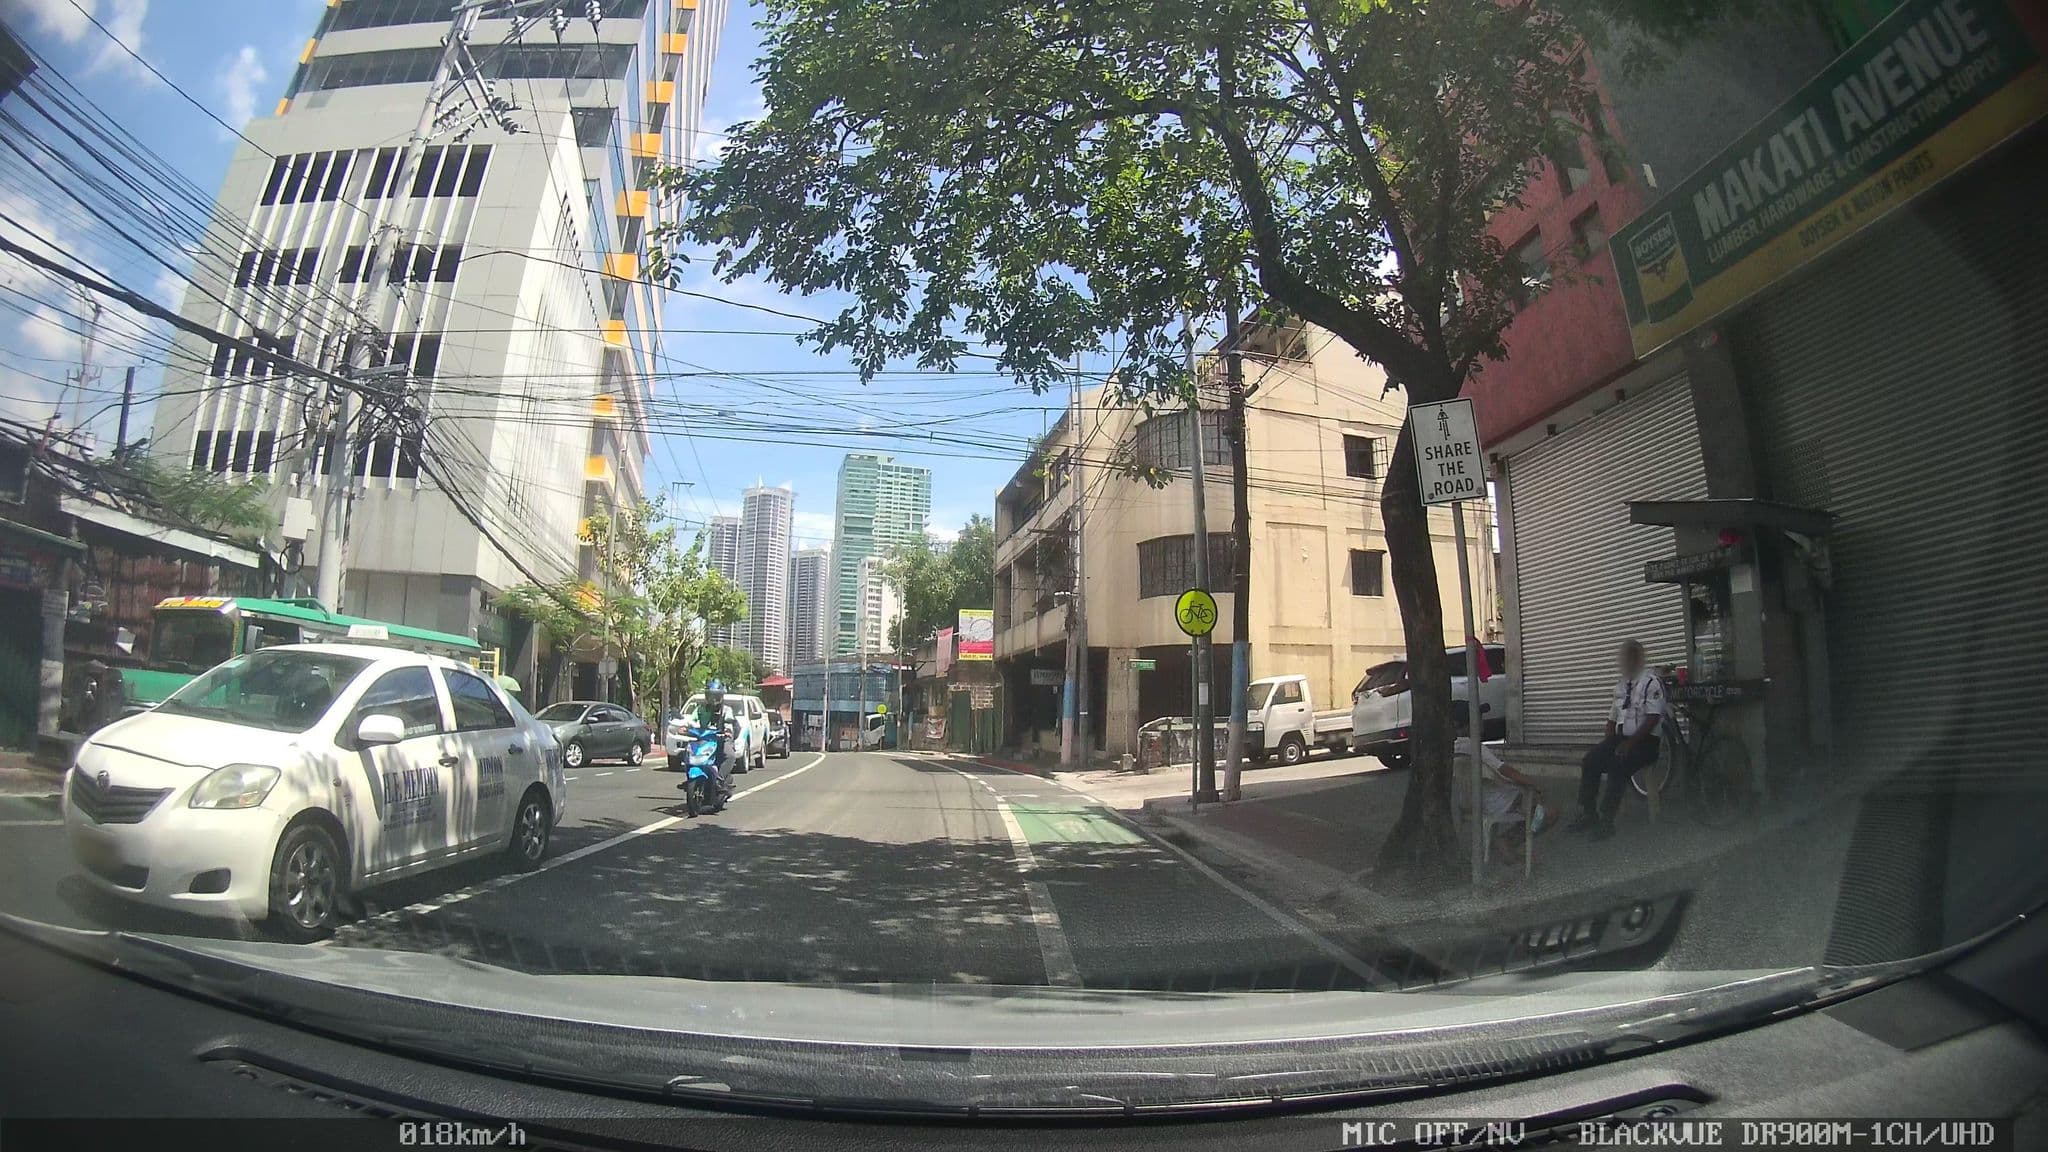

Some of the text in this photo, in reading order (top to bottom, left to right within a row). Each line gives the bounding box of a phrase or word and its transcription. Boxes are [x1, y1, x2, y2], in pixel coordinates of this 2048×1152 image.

[1692, 0, 1989, 240] MAKATI AVENUE
[1706, 214, 1763, 264] LUMBER
[1760, 166, 1835, 229] HARDWARE
[1833, 158, 1849, 179] &
[1845, 82, 1952, 171] CONSTRUCTION
[1947, 43, 2000, 99] SUPPLY
[1634, 223, 1673, 259] BOYSEN
[1425, 441, 1472, 461] SHARE
[1438, 460, 1465, 477] THE
[1434, 477, 1474, 496] ROAD
